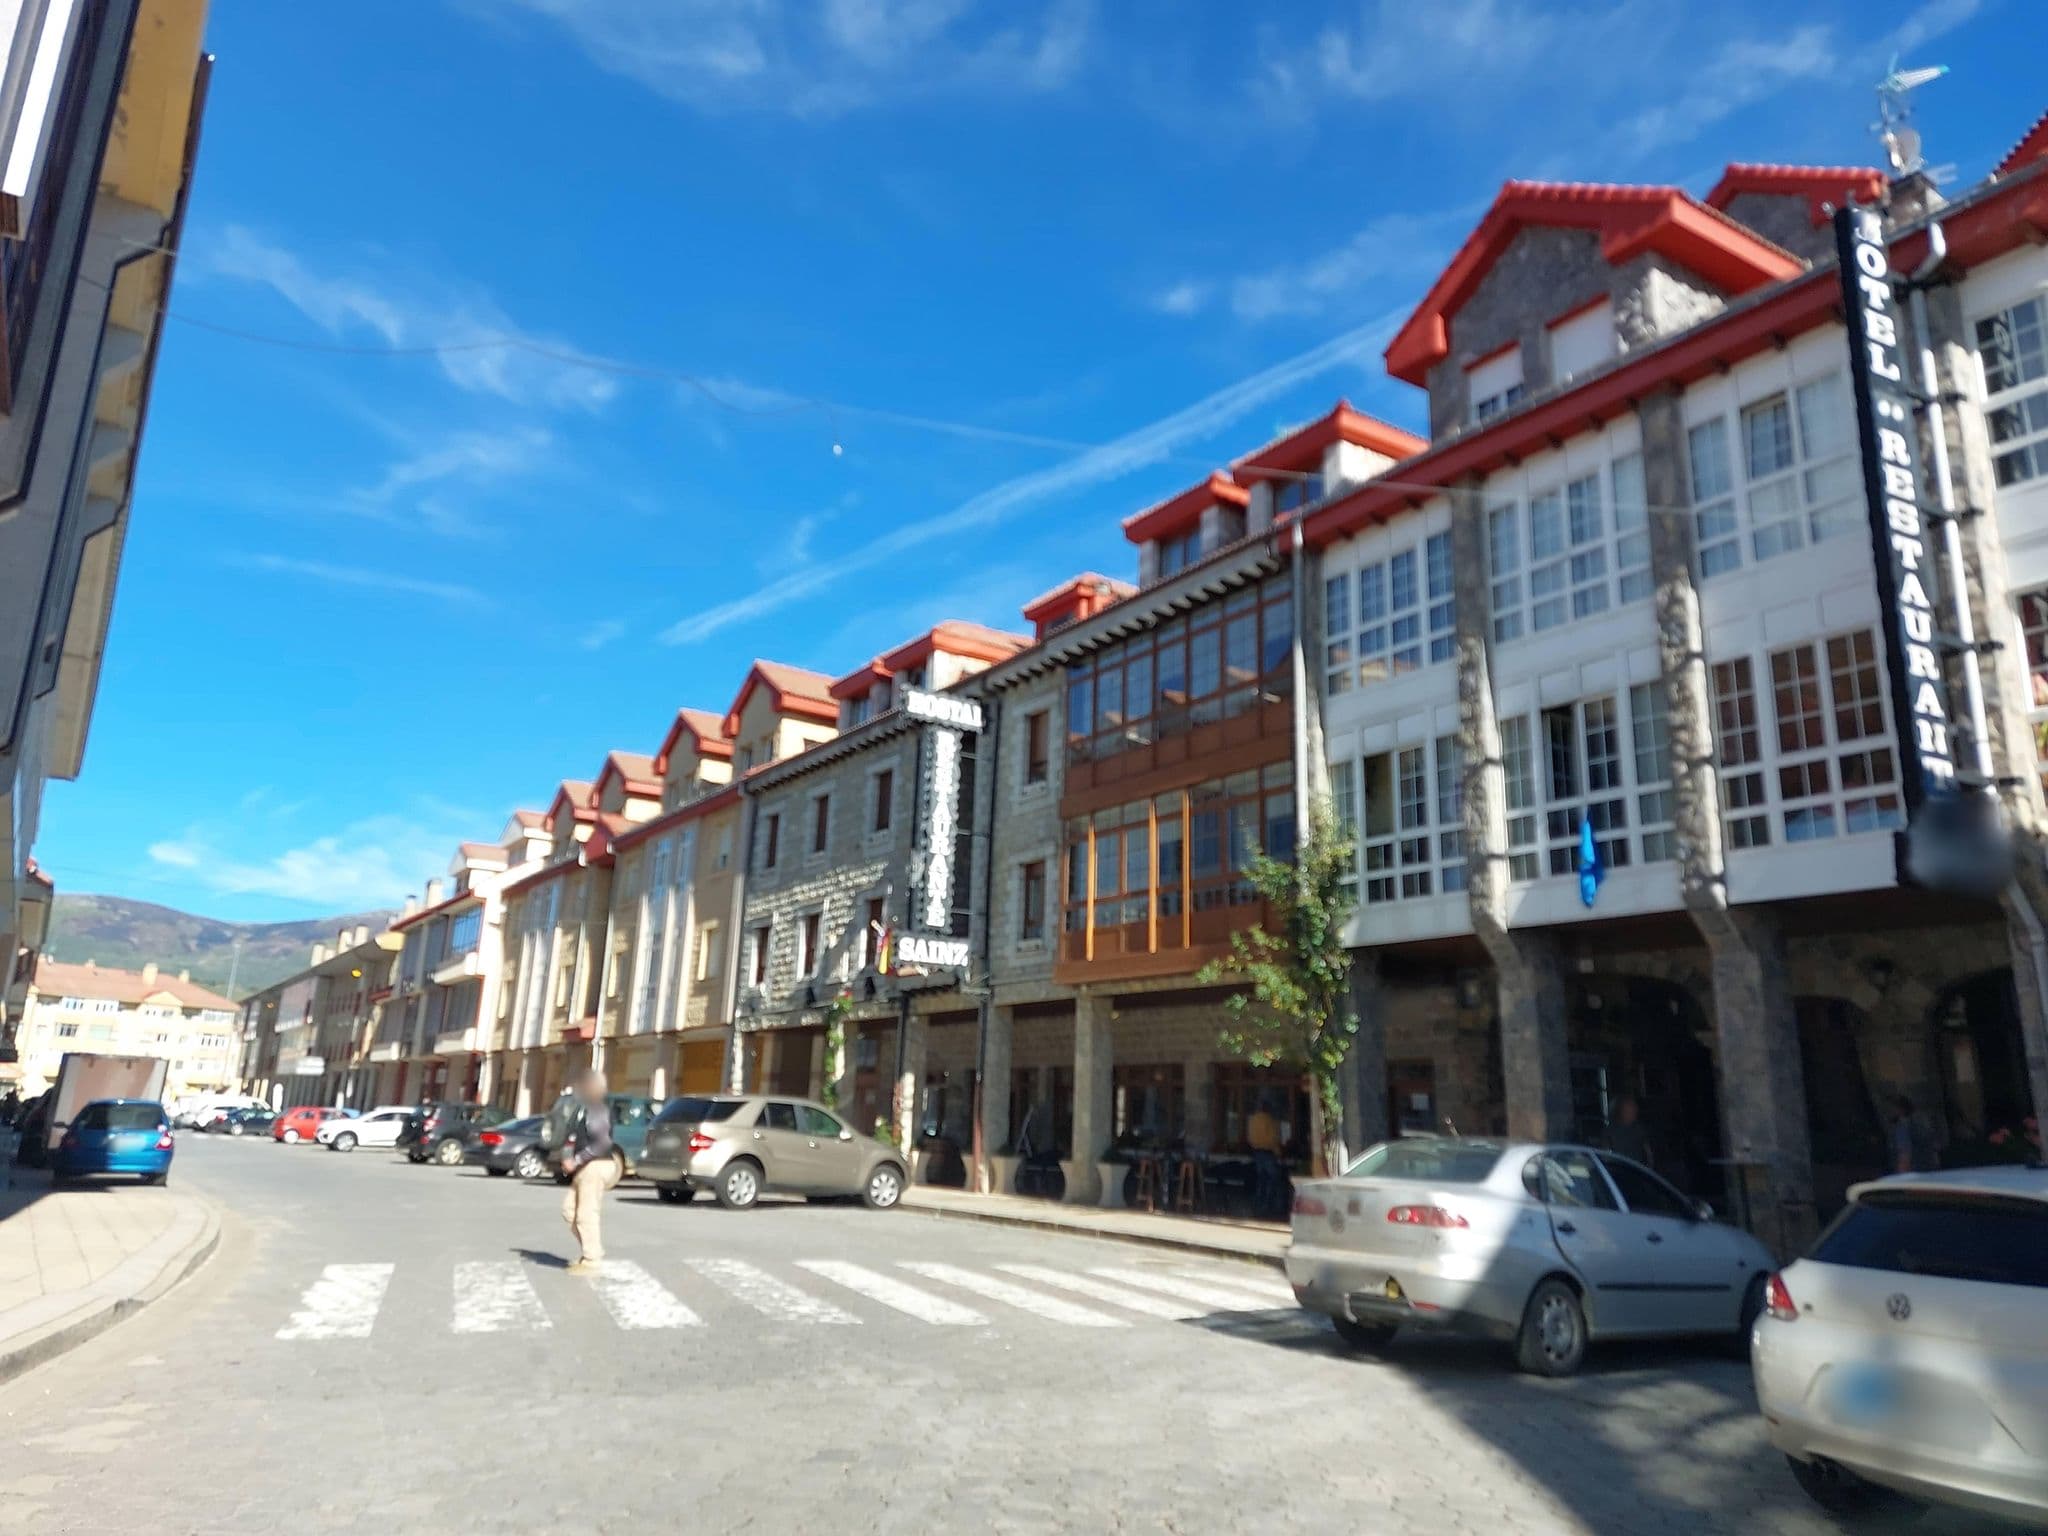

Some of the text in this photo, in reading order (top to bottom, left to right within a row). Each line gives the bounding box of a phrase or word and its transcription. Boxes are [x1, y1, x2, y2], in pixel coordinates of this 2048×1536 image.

[1878, 426, 1957, 800] RESTAURANT
[907, 690, 983, 728] HOSTAL
[926, 730, 957, 928] RESTAURANTE
[899, 936, 969, 967] SAINZ
